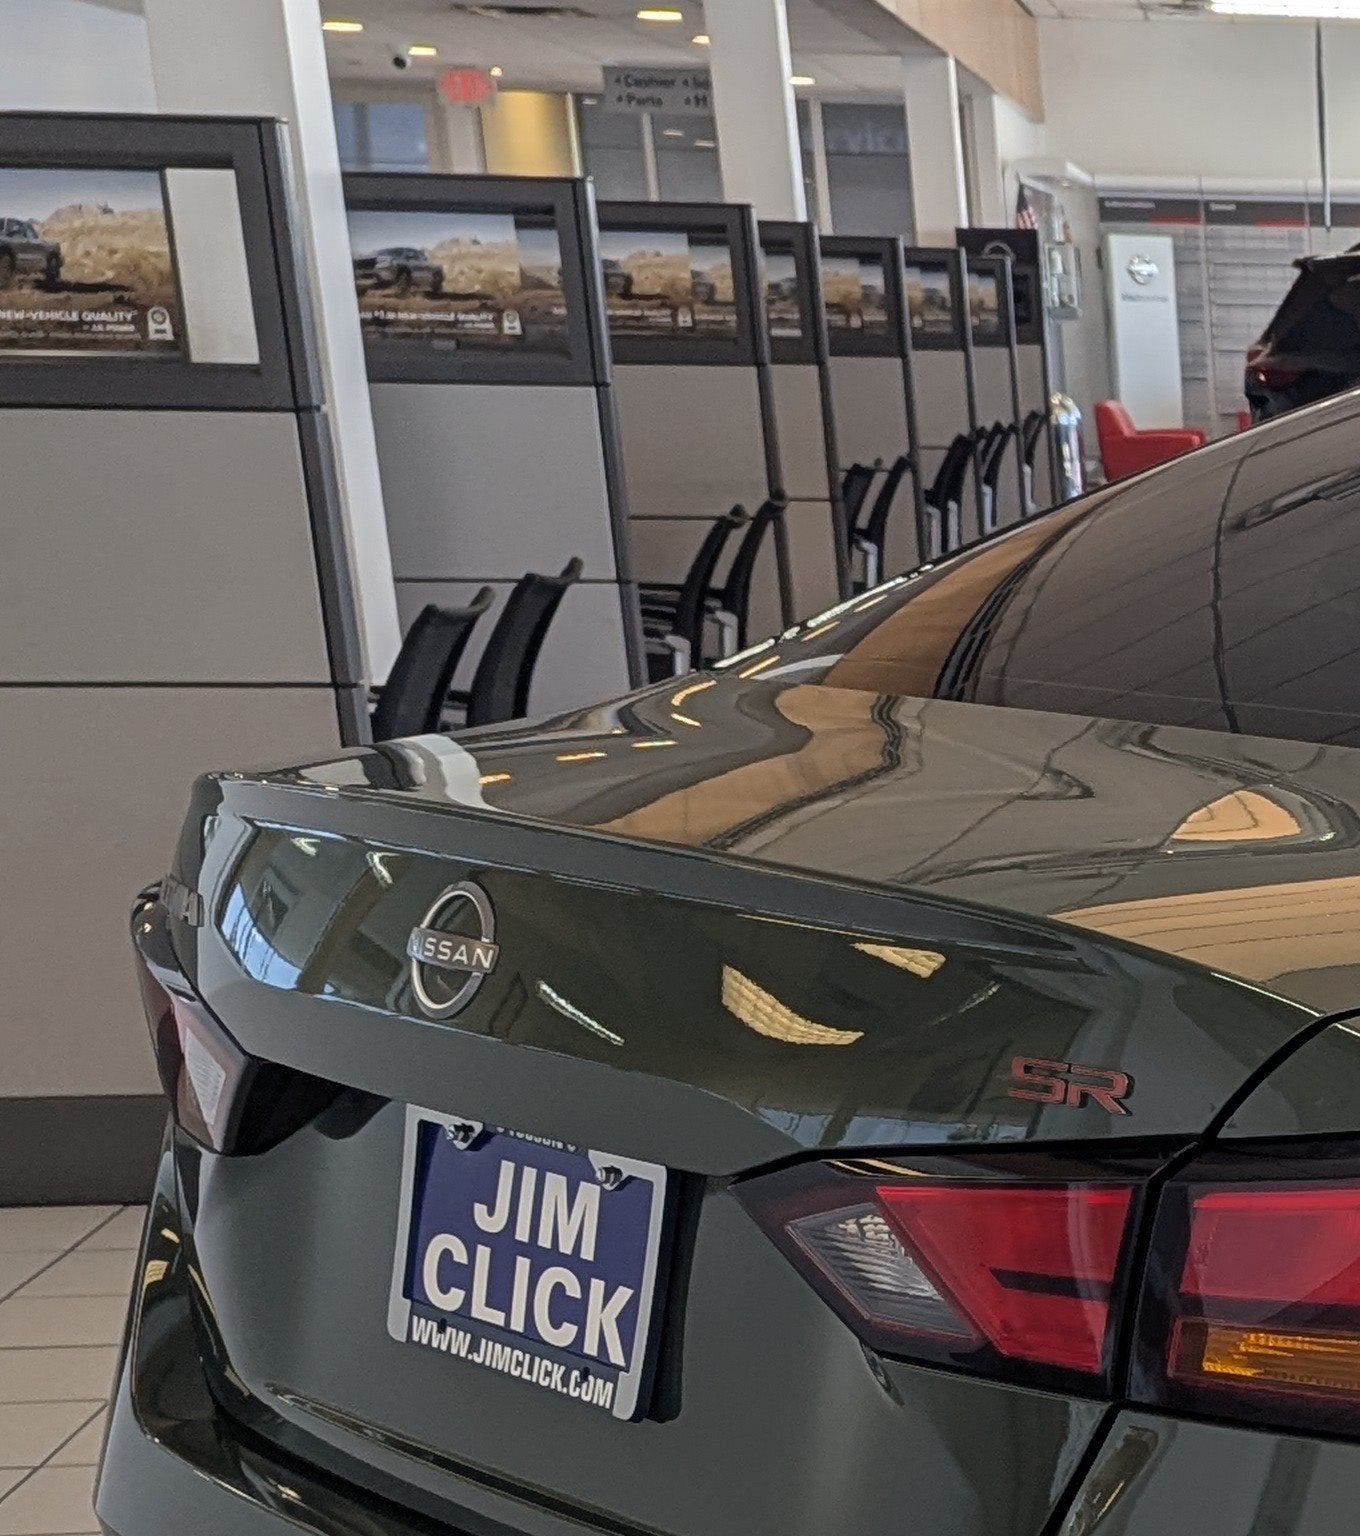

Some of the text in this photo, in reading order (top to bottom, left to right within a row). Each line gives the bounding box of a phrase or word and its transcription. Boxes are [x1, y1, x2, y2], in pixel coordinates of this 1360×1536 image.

[1008, 1056, 1129, 1115] SR
[472, 1159, 601, 1263] JIM
[421, 1232, 635, 1368] CLICK
[411, 1314, 614, 1410] WWW.JIMCLICK.COM
